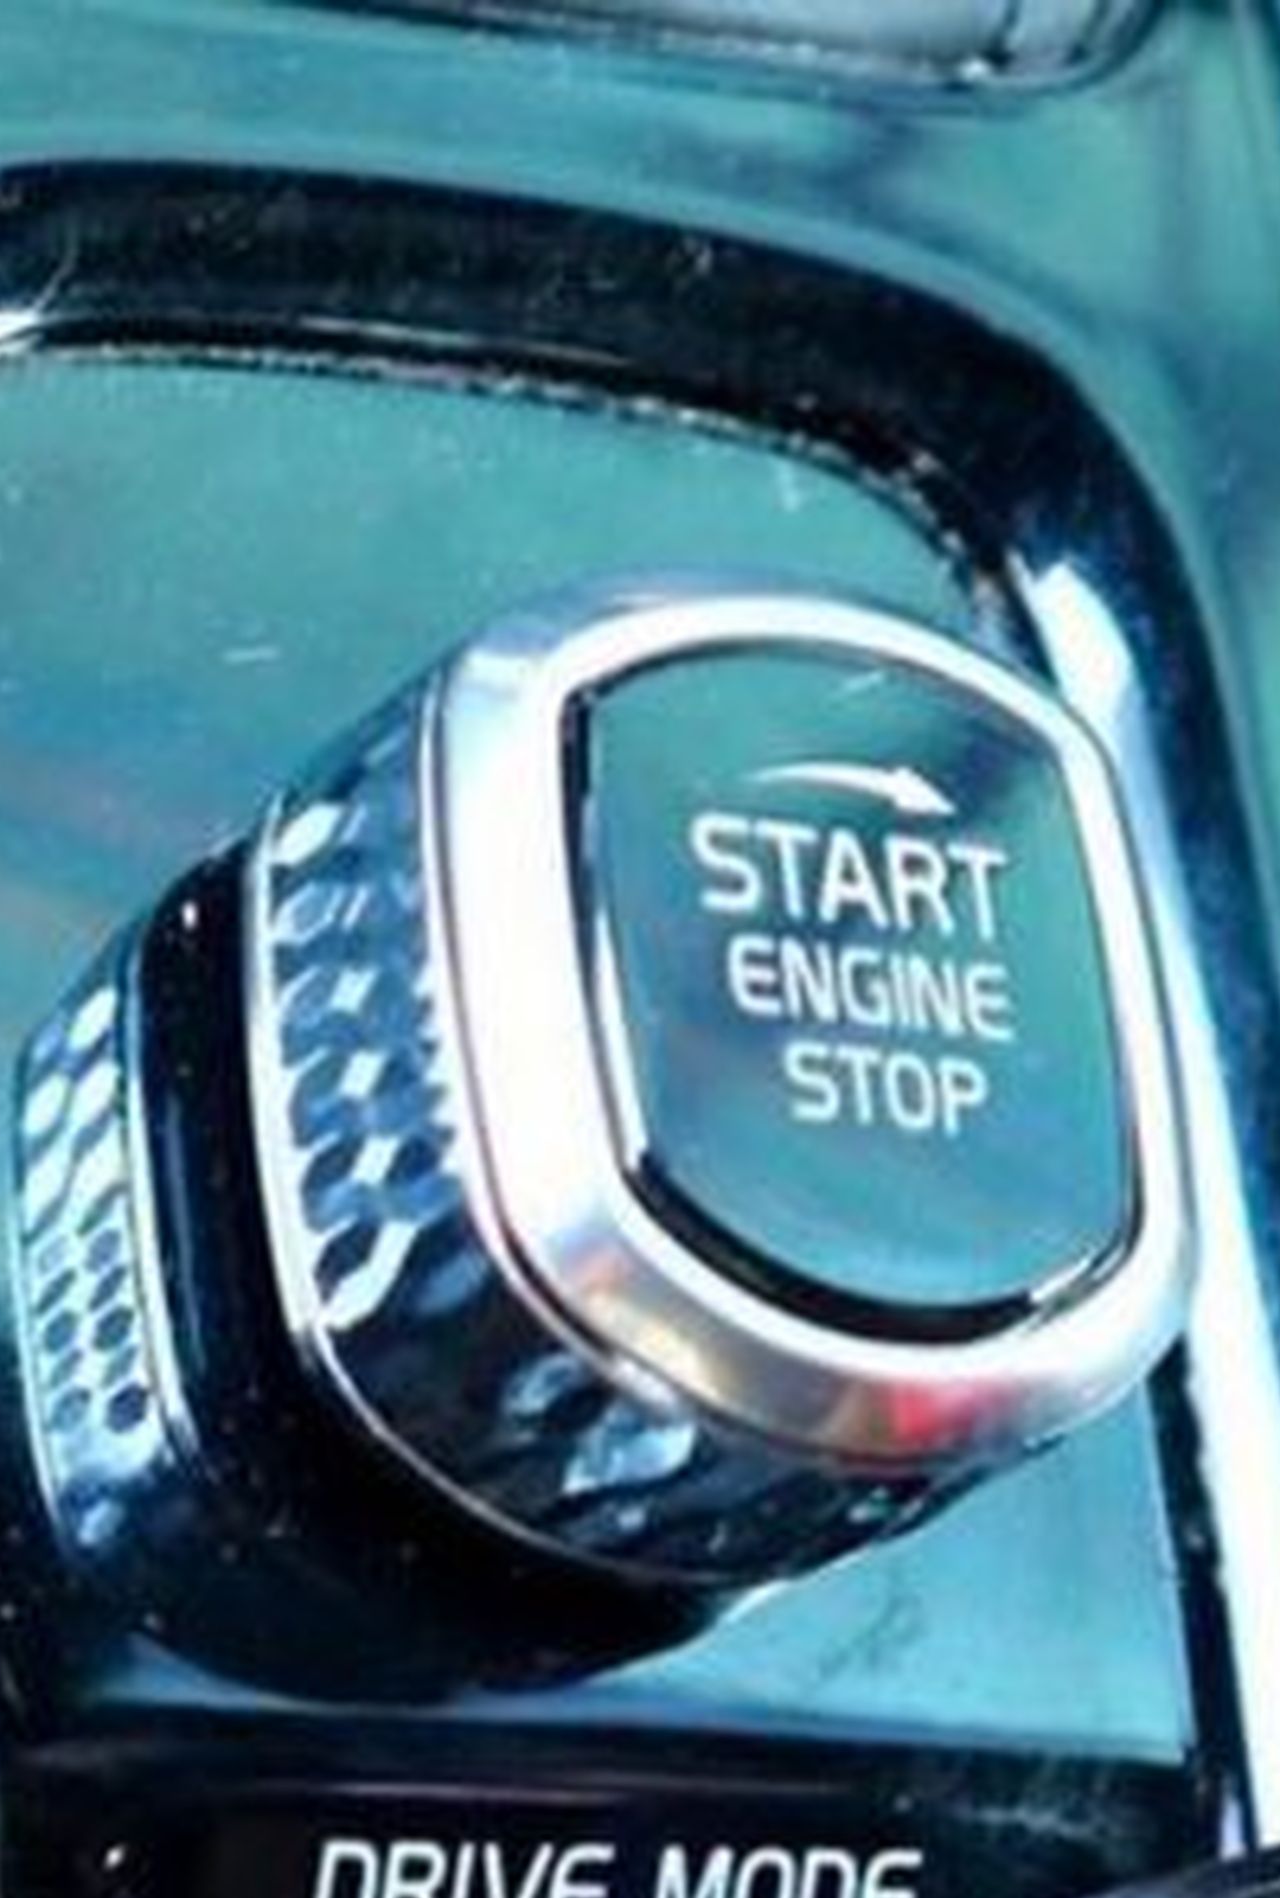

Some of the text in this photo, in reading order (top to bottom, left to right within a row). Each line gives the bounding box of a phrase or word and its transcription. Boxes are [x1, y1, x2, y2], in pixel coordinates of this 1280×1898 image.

[690, 811, 1008, 940] START
[727, 934, 1015, 1042] ENGINE
[783, 1040, 988, 1138] STOP
